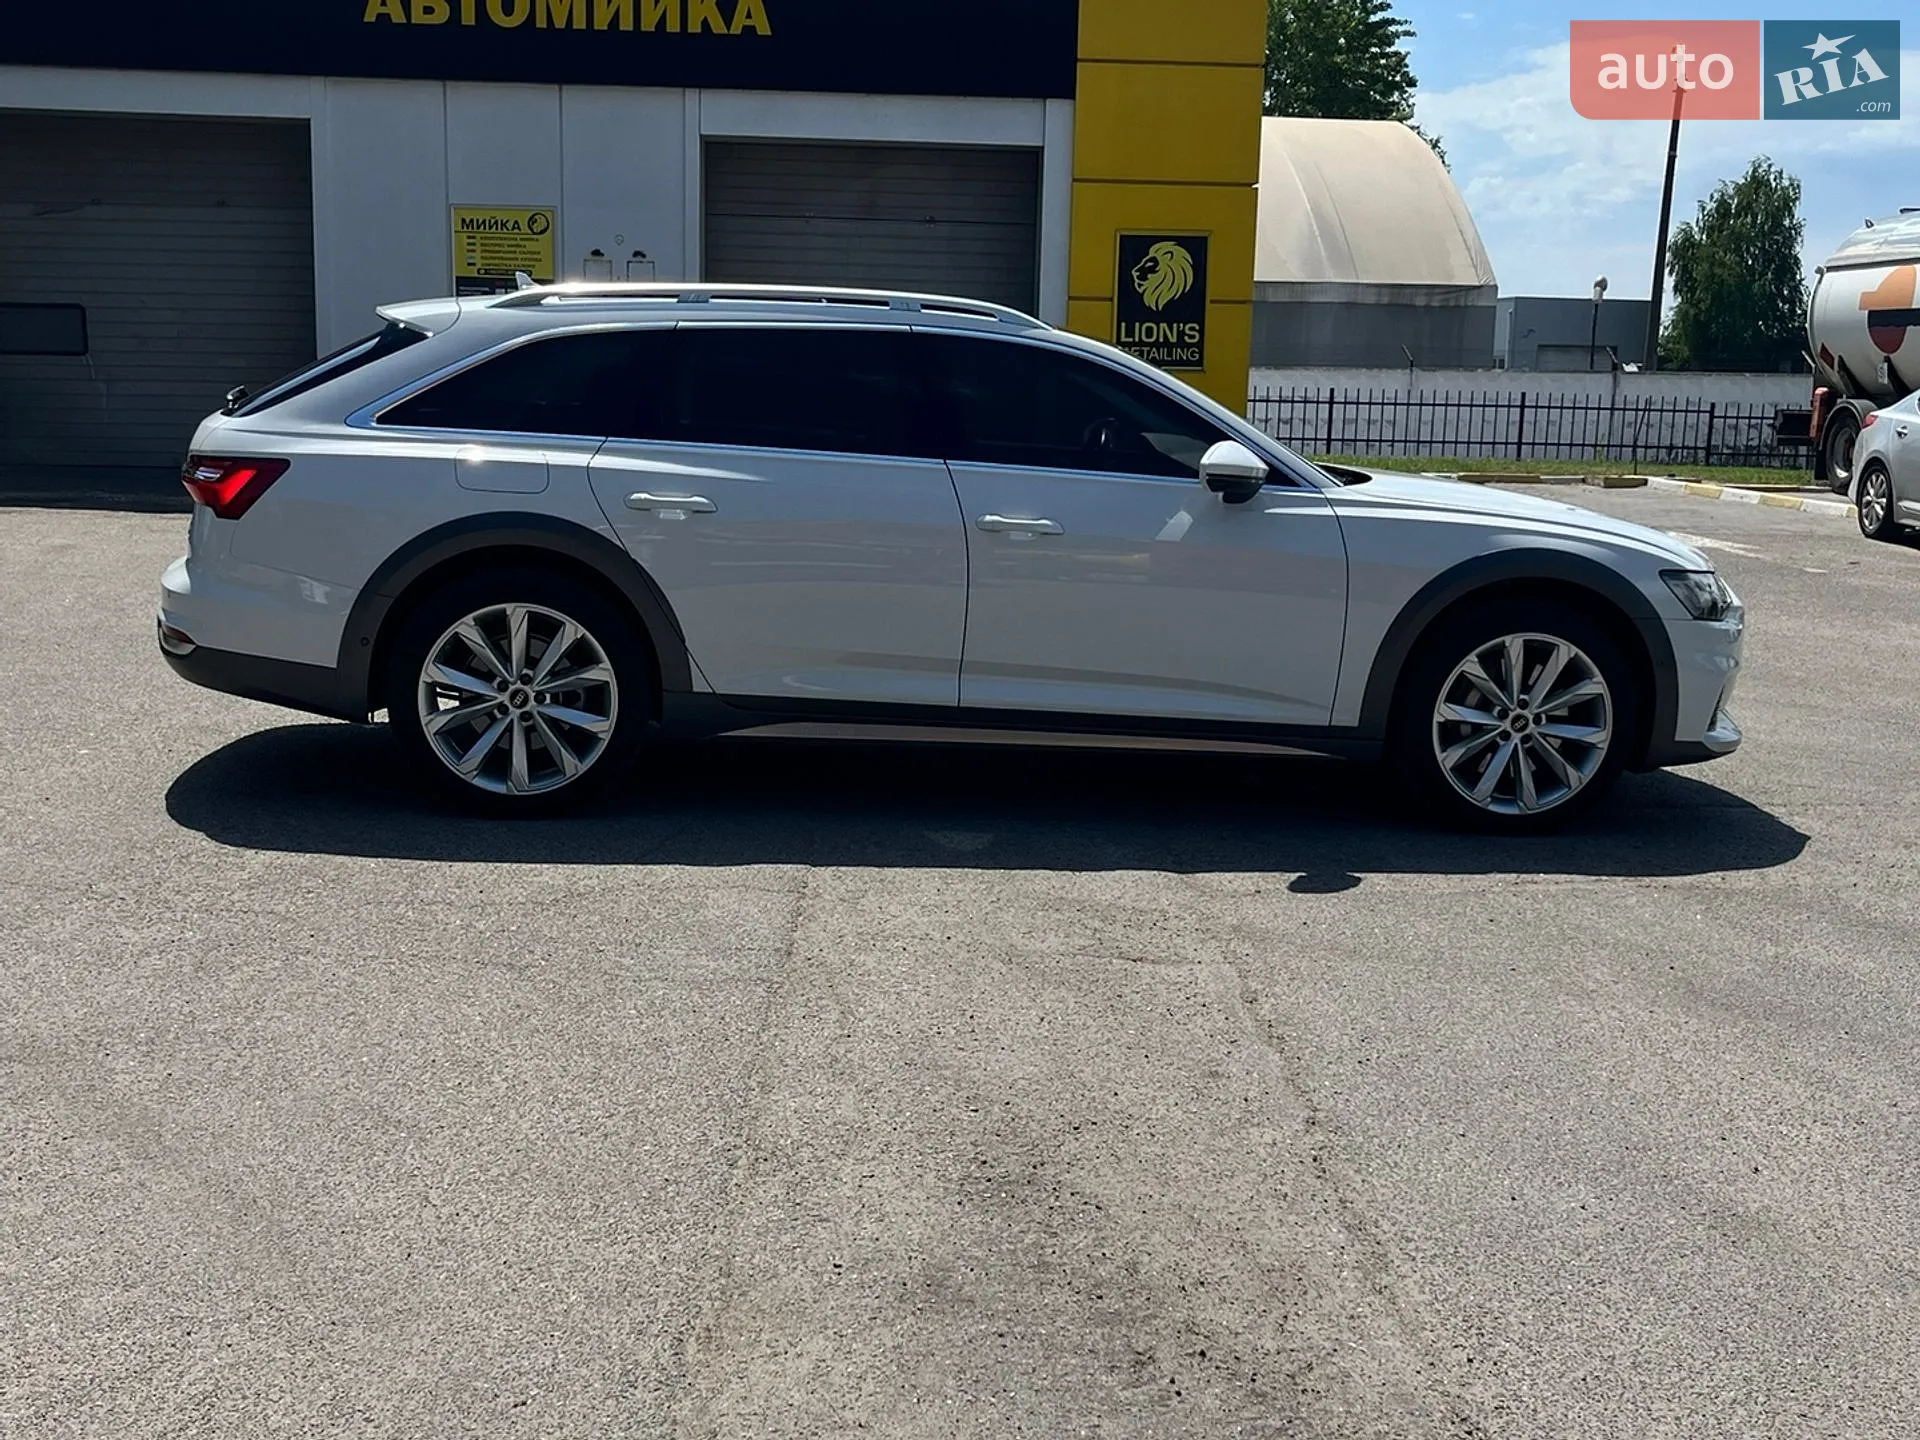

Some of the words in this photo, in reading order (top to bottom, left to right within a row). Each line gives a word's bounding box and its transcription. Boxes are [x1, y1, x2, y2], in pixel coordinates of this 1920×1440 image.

[460, 216, 522, 232] МИЙКА
[1120, 322, 1200, 343] LION'S
[1120, 346, 1200, 361] ETAILING
